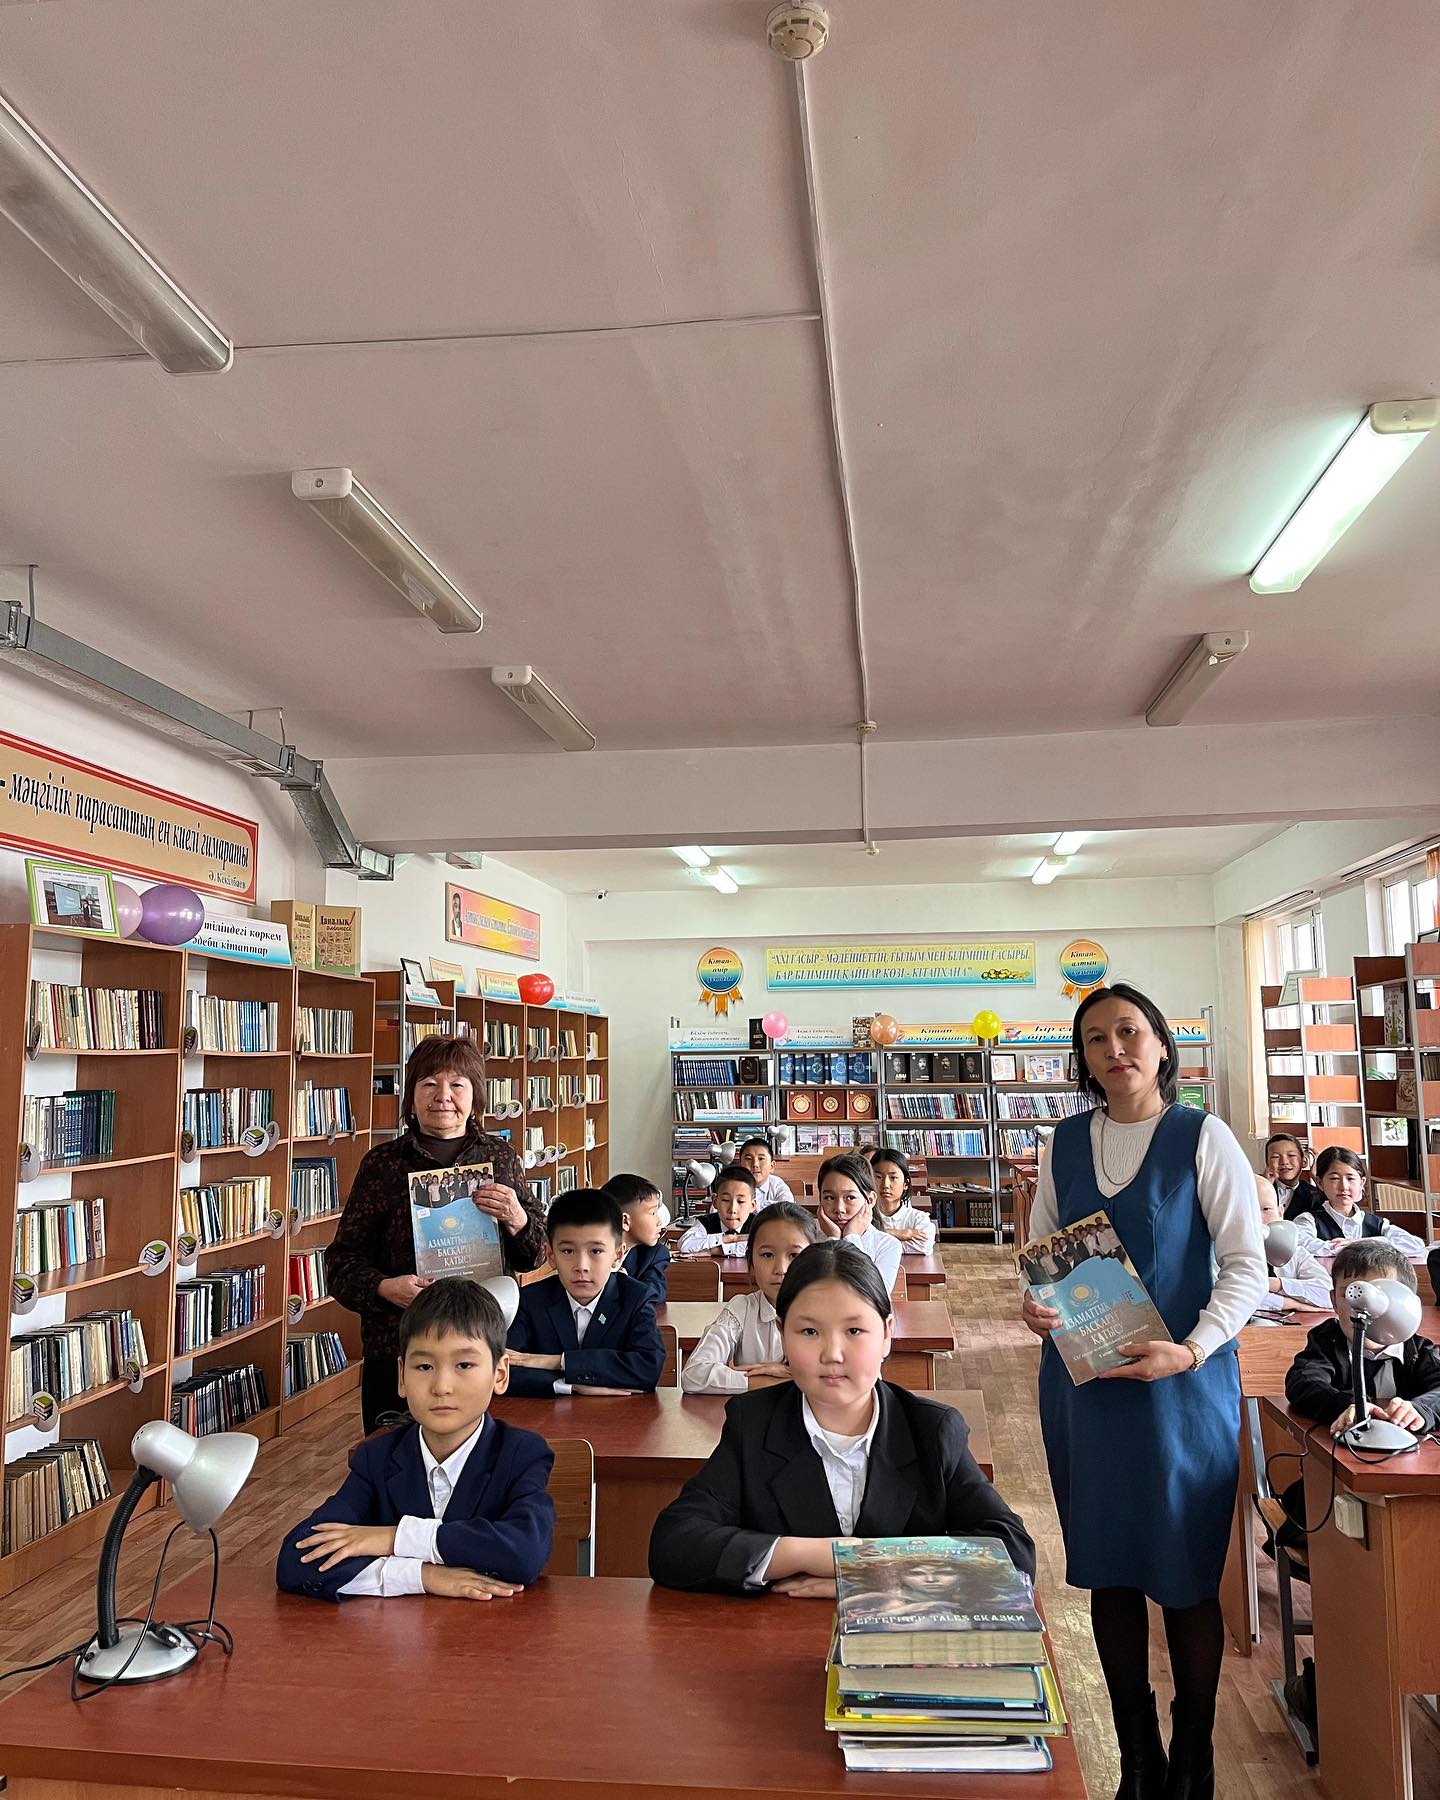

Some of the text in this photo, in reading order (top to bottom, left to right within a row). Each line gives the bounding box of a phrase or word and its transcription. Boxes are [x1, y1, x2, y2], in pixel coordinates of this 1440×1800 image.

[8, 771, 72, 816] мәңгілік
[75, 791, 156, 849] парасаттың
[158, 821, 170, 850] ең
[204, 920, 247, 937] тіліндегі
[221, 939, 268, 957] кітаптар
